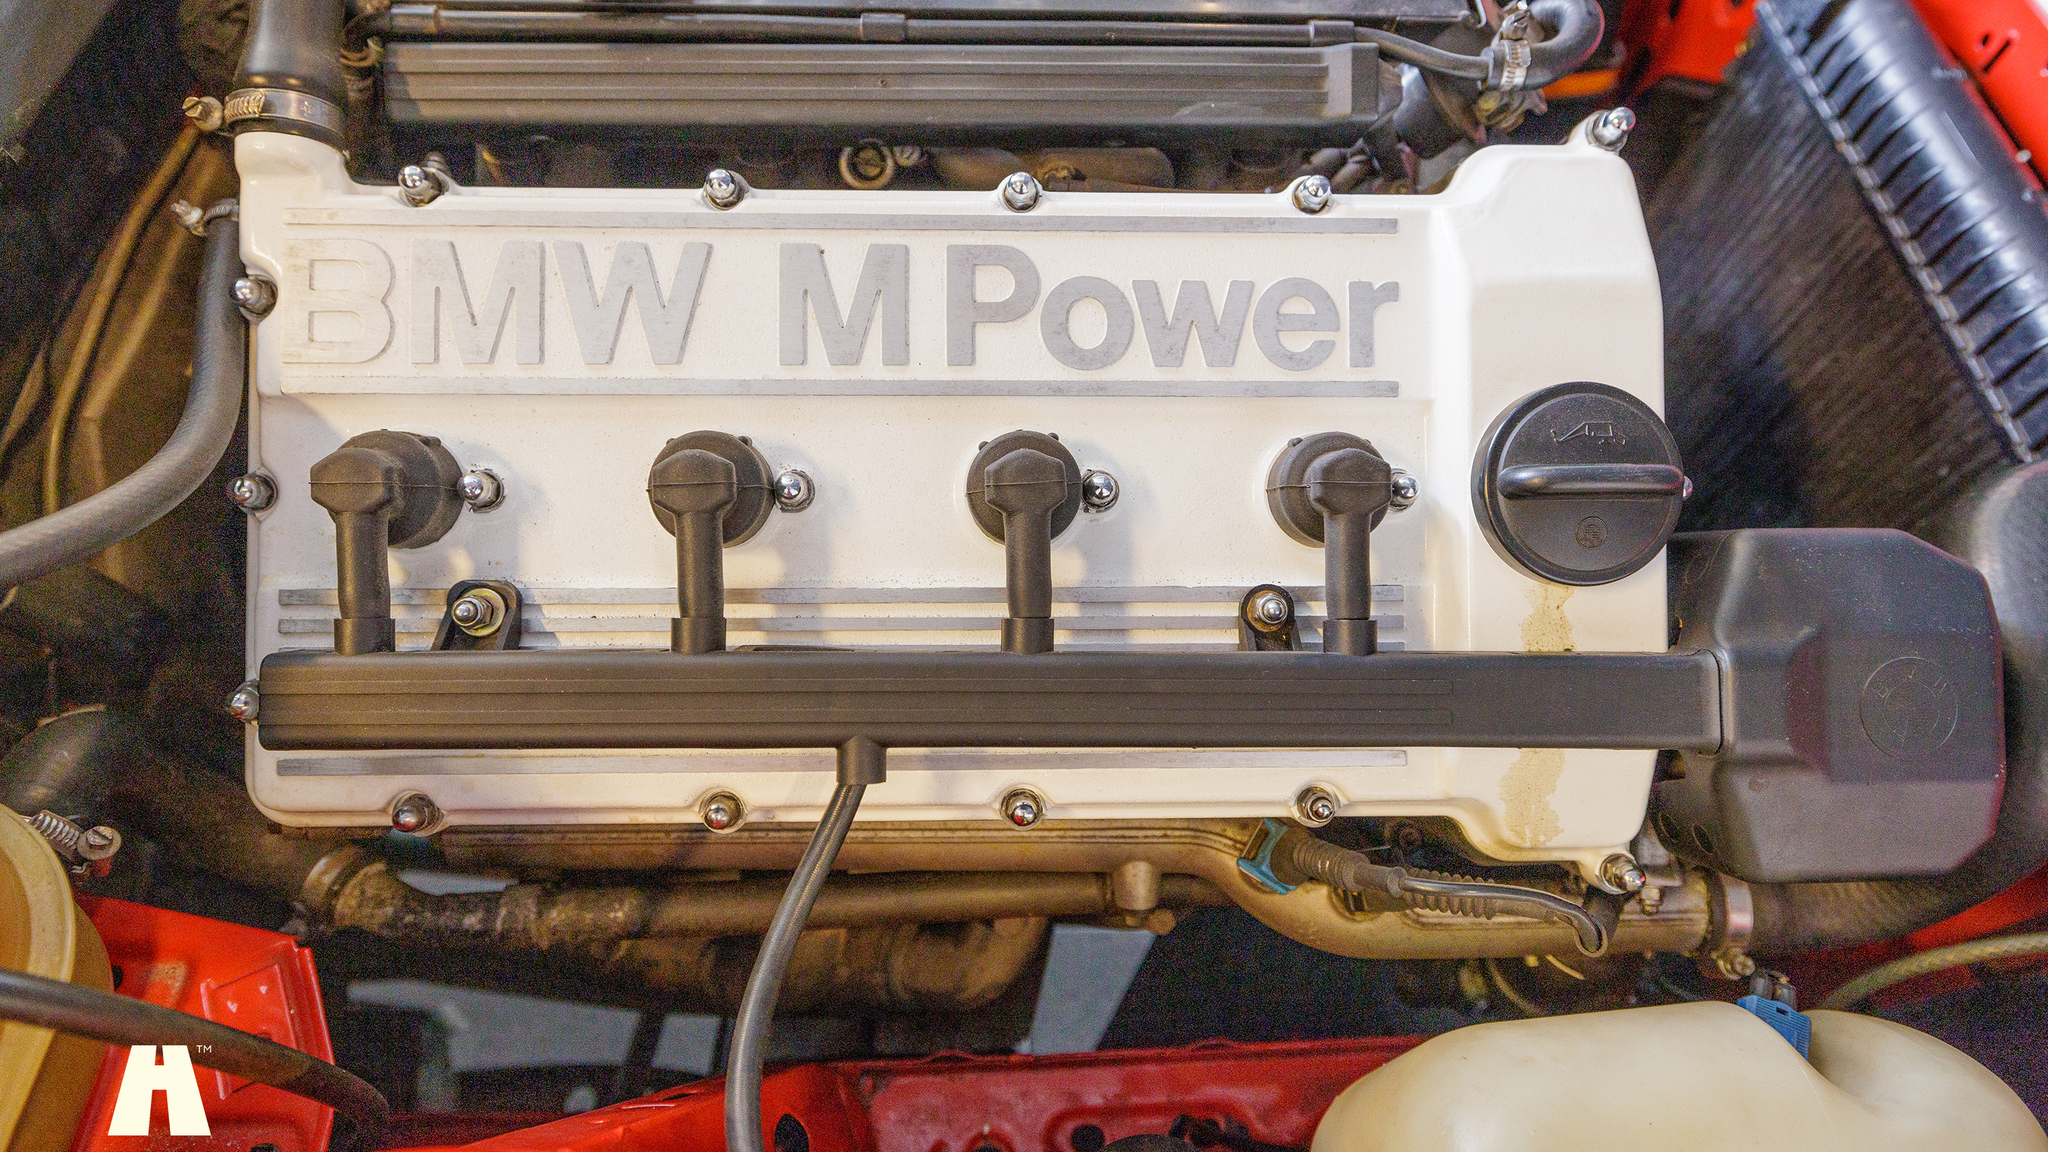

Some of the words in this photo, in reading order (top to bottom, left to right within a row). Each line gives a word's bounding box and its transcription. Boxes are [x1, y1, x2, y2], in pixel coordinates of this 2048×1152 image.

[282, 238, 714, 366] BMW
[778, 243, 910, 366] M
[946, 243, 1400, 371] Power
